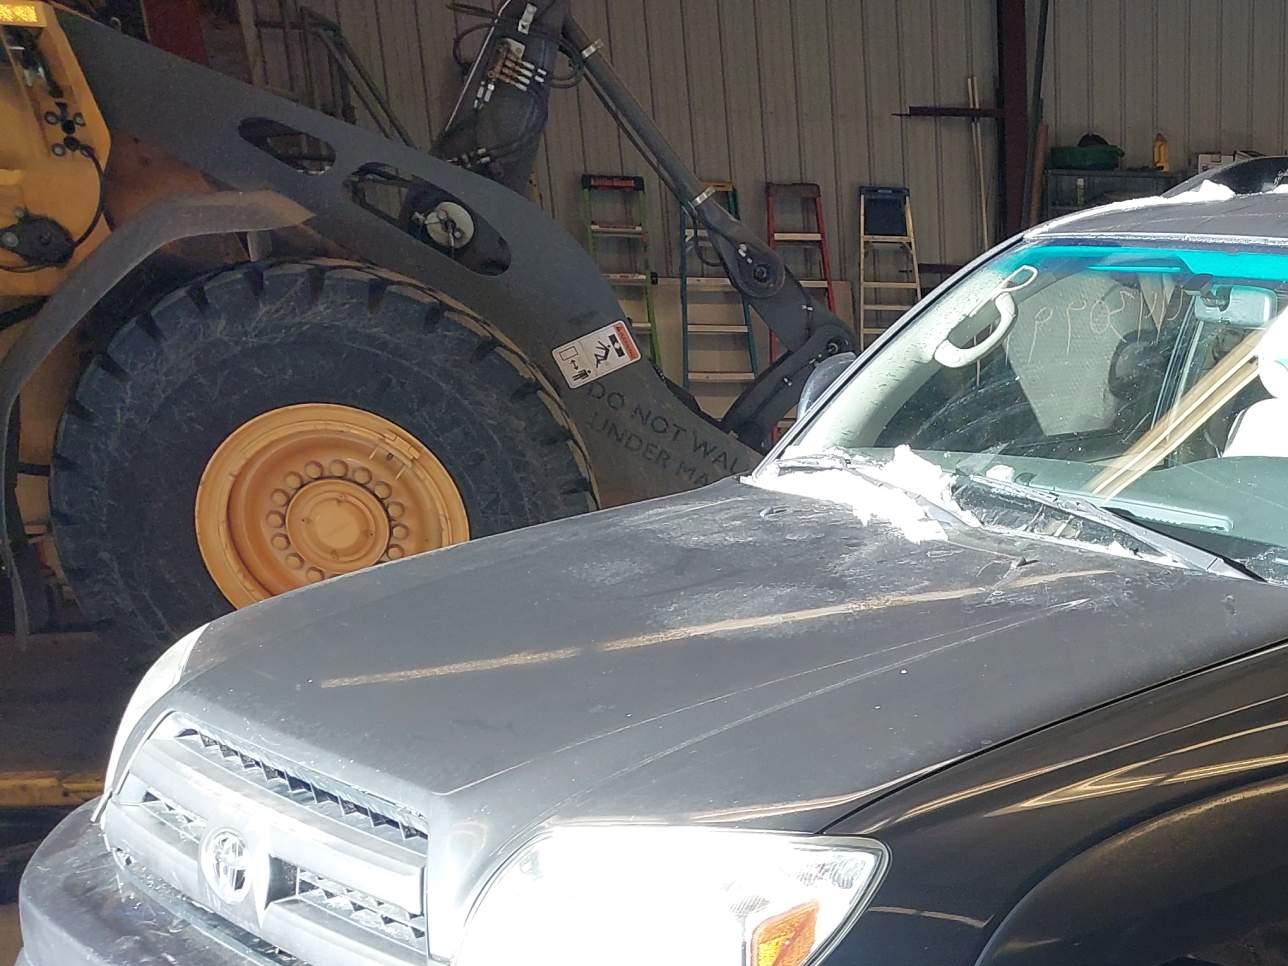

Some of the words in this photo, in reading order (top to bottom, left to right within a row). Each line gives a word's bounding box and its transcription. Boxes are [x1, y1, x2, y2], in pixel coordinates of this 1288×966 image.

[585, 412, 671, 469] UNDER
[586, 381, 625, 411] DO
[631, 404, 687, 442] NOT
